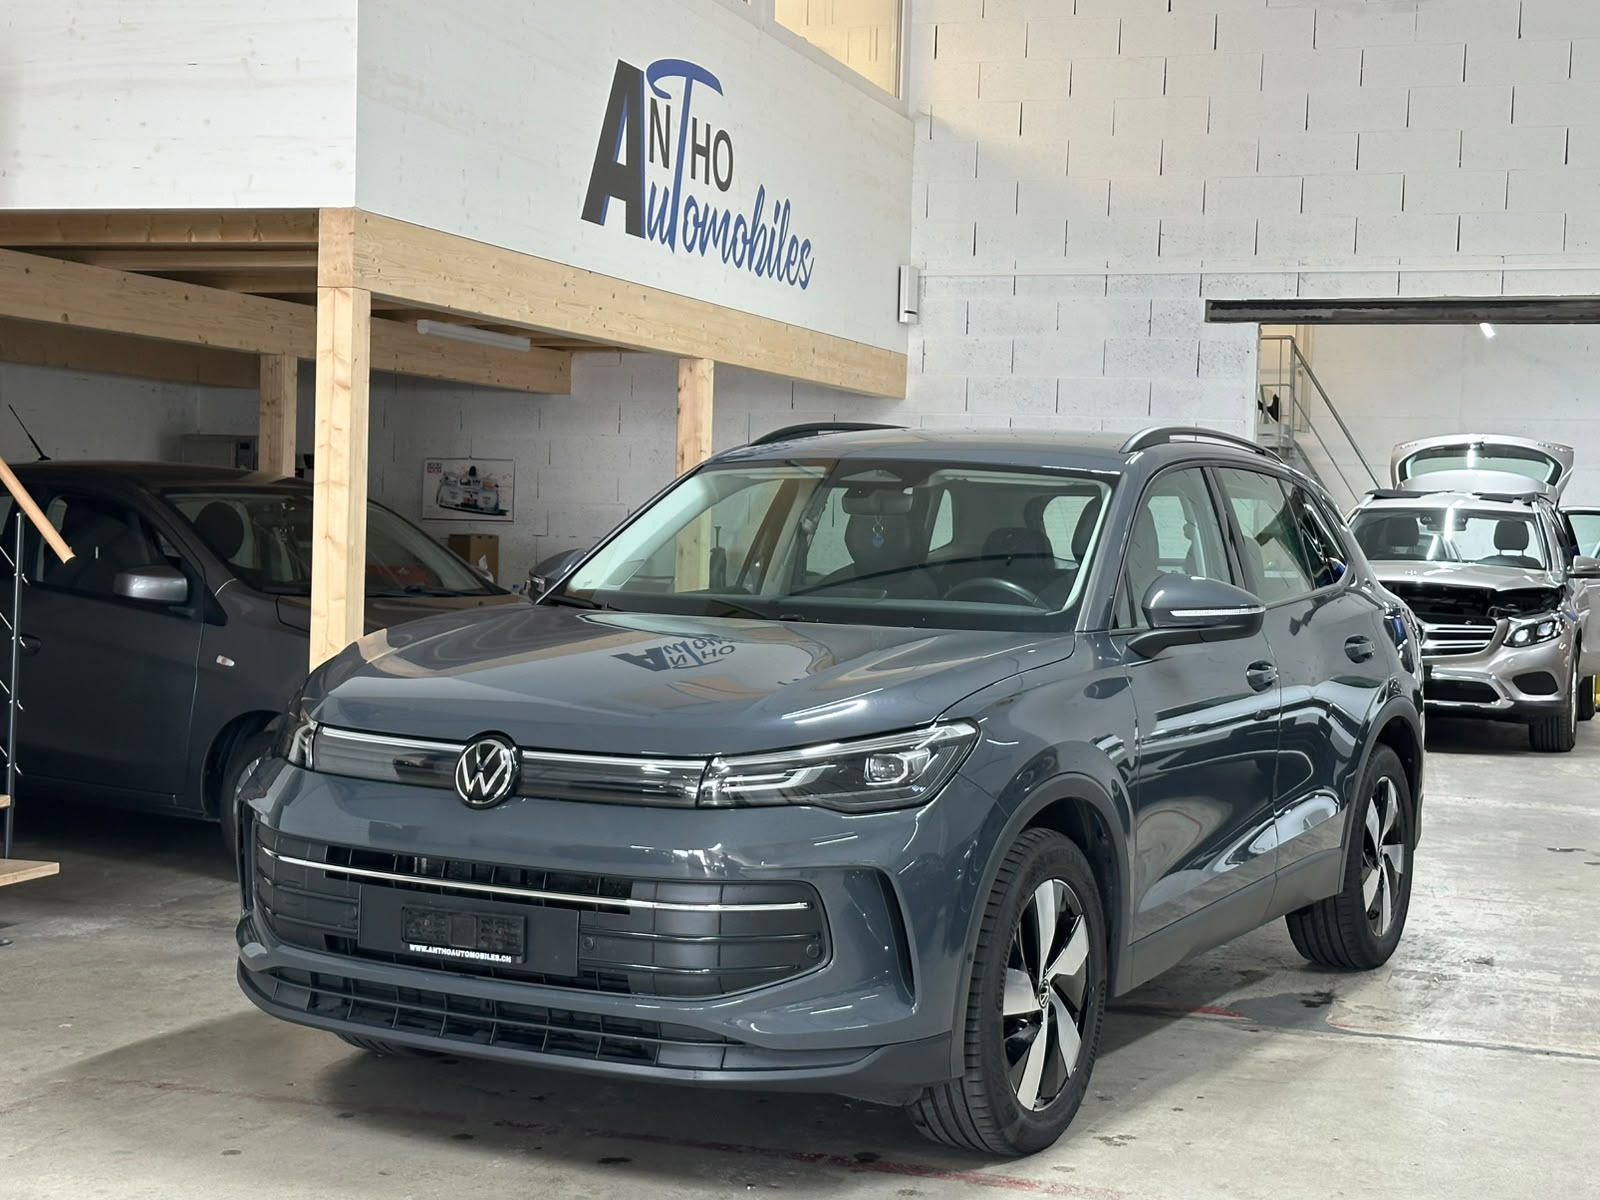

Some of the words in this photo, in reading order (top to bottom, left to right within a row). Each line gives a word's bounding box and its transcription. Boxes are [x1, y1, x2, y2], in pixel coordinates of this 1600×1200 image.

[580, 58, 734, 254] ANTHO
[456, 739, 512, 804] VW
[409, 944, 512, 963] WWW.ANTHOAUTOMOBILES.CH
